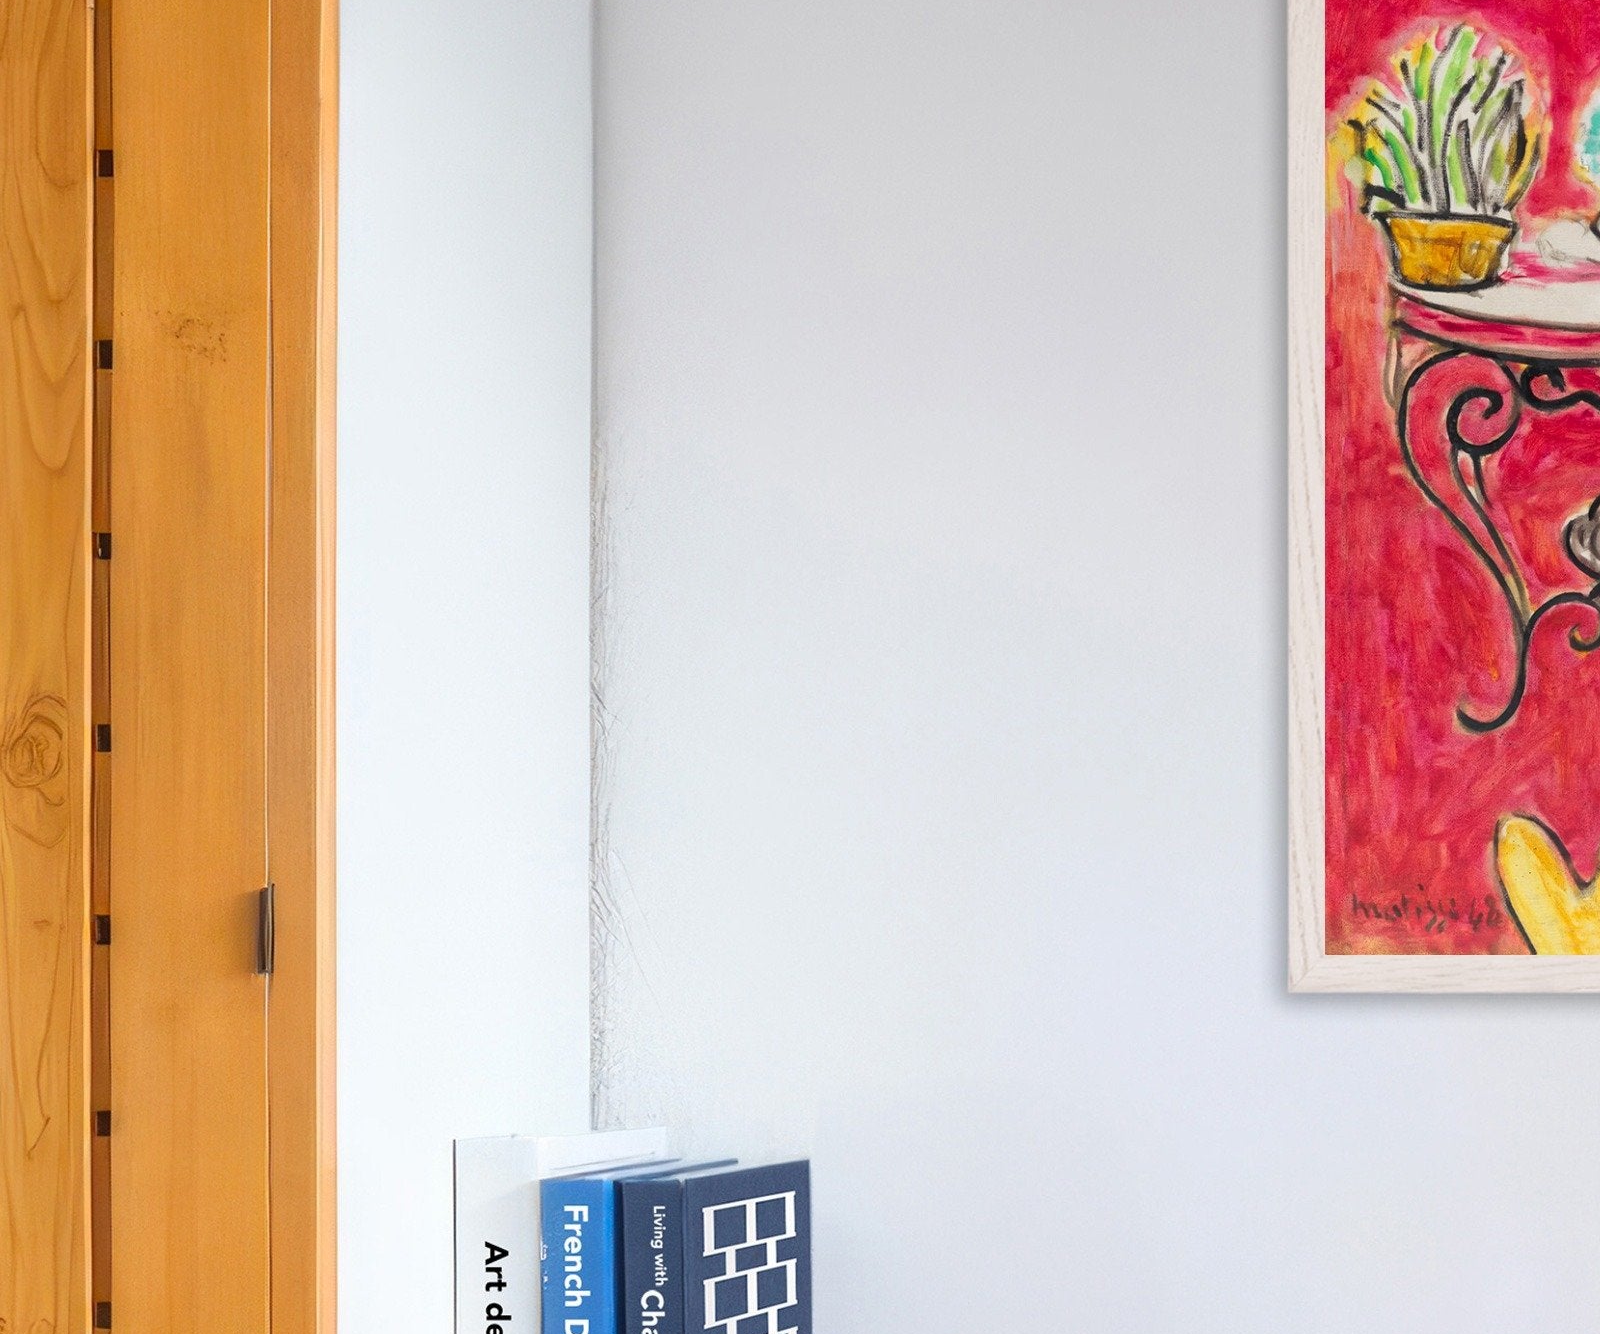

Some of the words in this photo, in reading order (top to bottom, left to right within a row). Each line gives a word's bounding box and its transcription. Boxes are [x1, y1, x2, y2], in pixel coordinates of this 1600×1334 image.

[651, 1205, 666, 1249] Living
[485, 1242, 509, 1291] Art
[563, 1205, 591, 1307] French
[654, 1253, 669, 1286] with
